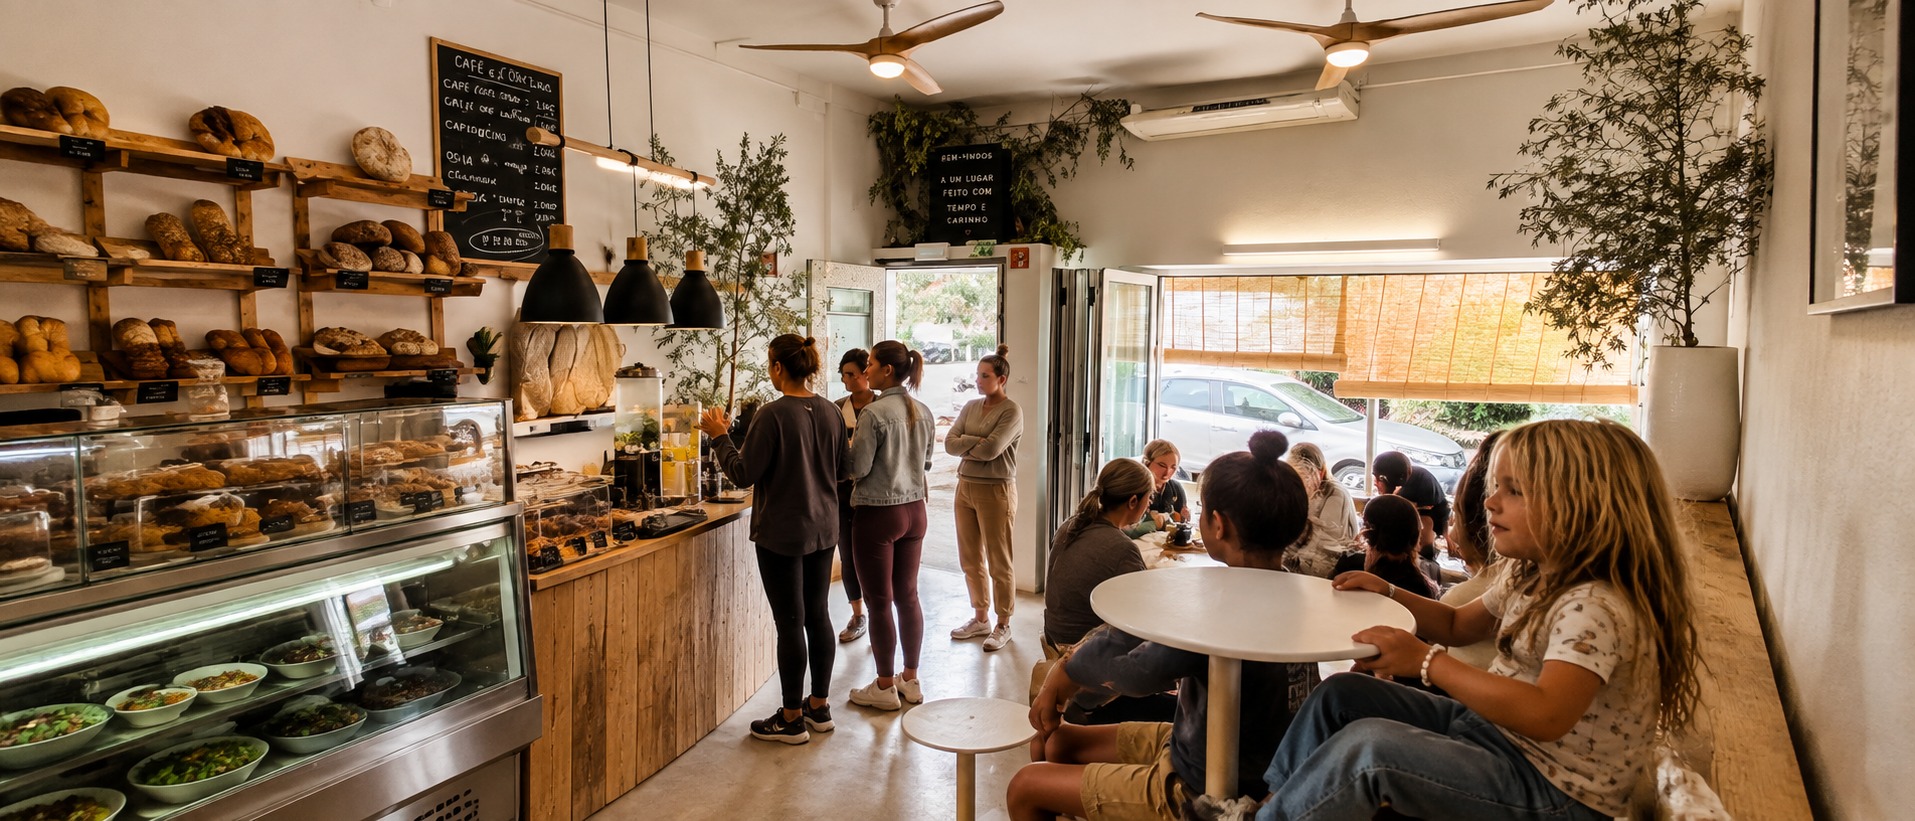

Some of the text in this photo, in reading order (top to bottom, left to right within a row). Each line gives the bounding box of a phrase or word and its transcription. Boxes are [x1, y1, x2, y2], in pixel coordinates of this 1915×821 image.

[940, 176, 947, 184] A
[965, 174, 994, 183] LUGAR
[942, 187, 992, 197] FEITO COM
[981, 203, 987, 211] E
[946, 216, 988, 224] CARINHO
